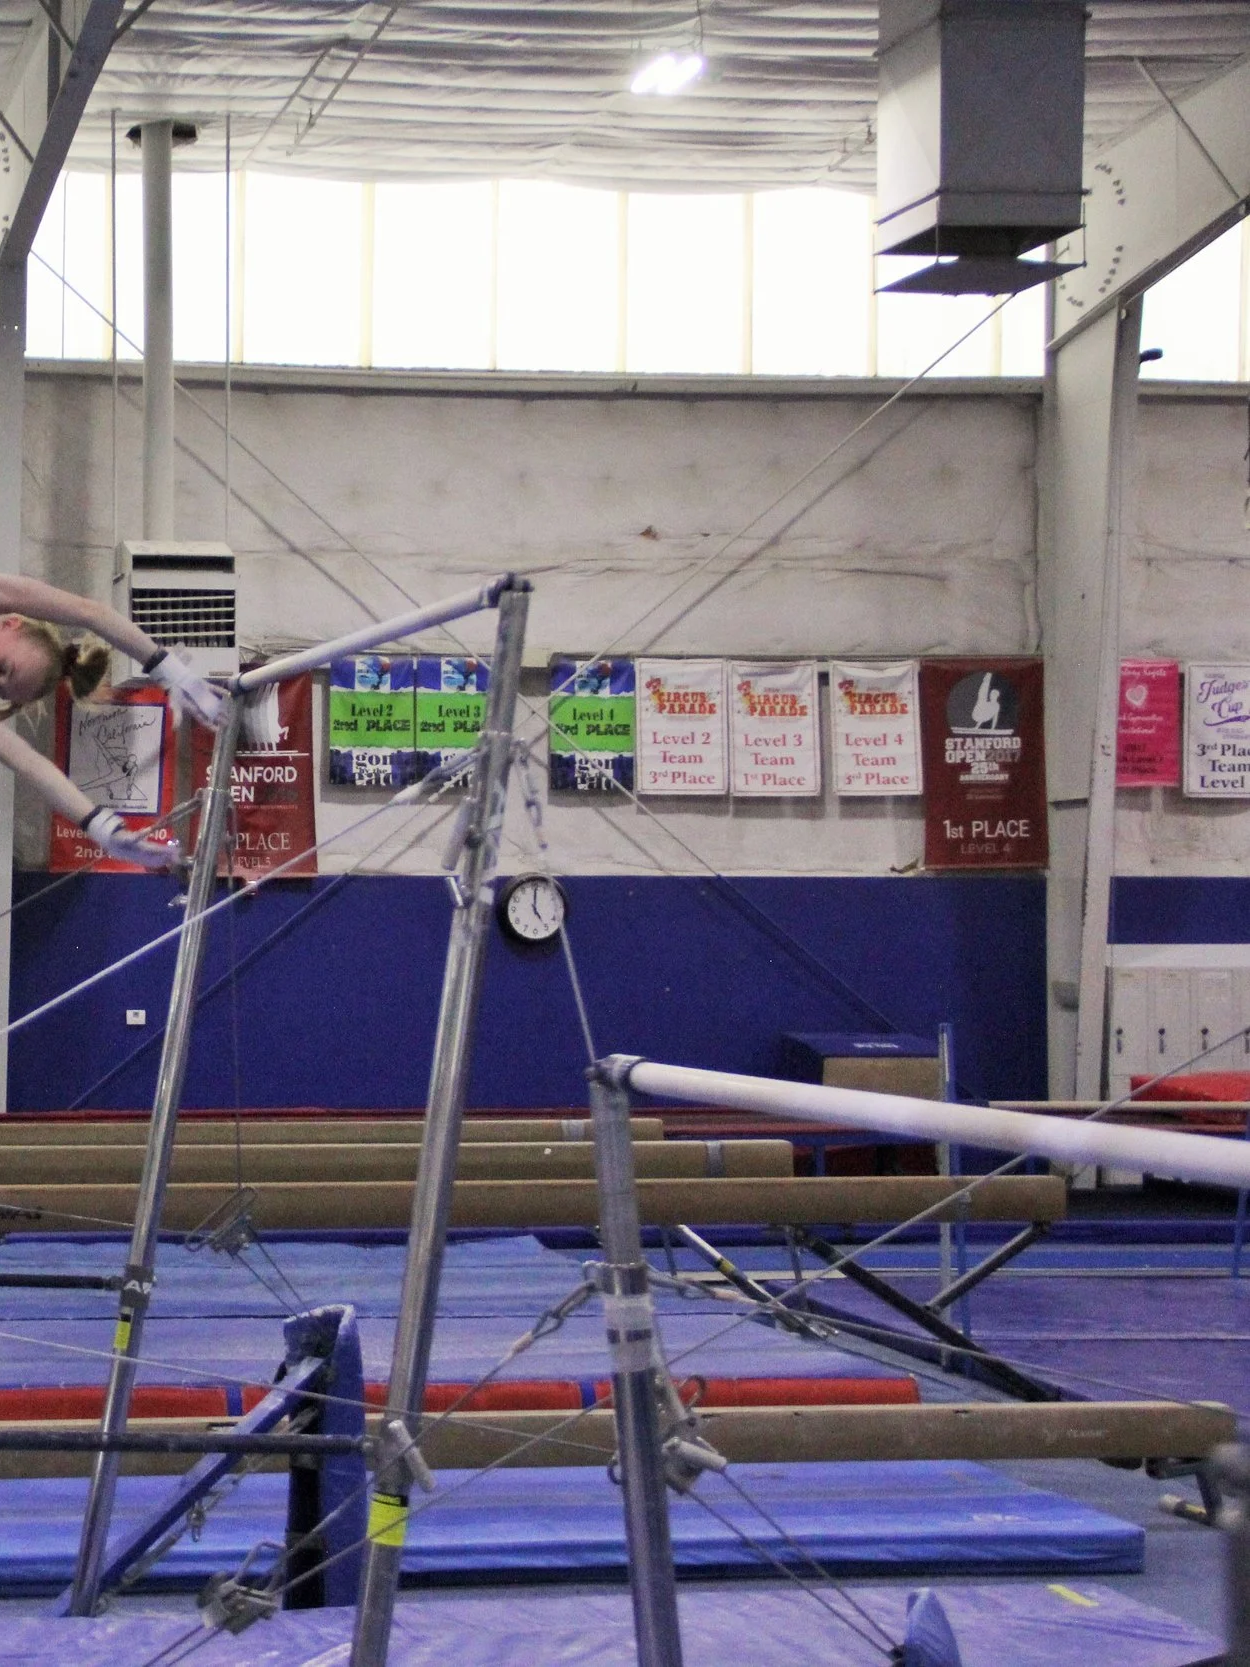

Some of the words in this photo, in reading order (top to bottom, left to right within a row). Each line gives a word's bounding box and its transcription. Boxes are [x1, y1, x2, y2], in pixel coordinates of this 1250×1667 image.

[659, 692, 708, 703] CIRCUS
[749, 694, 798, 706] CIRCUS
[849, 692, 898, 704] CIRCUS
[351, 704, 383, 717] Level
[386, 705, 393, 716] 2
[438, 705, 470, 718] Level
[474, 706, 481, 718] 3
[658, 703, 717, 714] PARADE
[749, 705, 808, 716] PARADE
[850, 704, 909, 715] PARADE
[1211, 697, 1243, 718] Cup
[572, 708, 603, 721] Level
[97, 716, 156, 745] California
[333, 720, 358, 732] 2nd
[366, 720, 411, 732] PLACE
[420, 720, 445, 733] 2nd
[453, 721, 481, 733] PLA
[586, 724, 631, 736] PLACE
[653, 732, 695, 744] Level
[702, 732, 711, 744] 2
[744, 734, 786, 747] Level
[793, 734, 802, 746] 3
[845, 733, 887, 746] Level
[894, 733, 904, 745] 4
[945, 737, 1021, 750] STANFORD
[945, 750, 986, 763] OPEN
[986, 750, 1021, 762] 2017
[1197, 743, 1217, 757] 3rd
[660, 751, 703, 764] Team
[752, 753, 795, 765] Team
[853, 753, 896, 766] Team
[206, 766, 297, 783] SANFORD
[649, 770, 668, 784] 3rd
[672, 771, 715, 784] Place
[744, 773, 759, 786] 1st
[762, 773, 806, 785] Place
[865, 772, 909, 785] Place
[1200, 775, 1245, 789] Level
[230, 786, 254, 802] EN
[56, 826, 87, 839] Leve
[943, 820, 964, 839] 1st
[972, 820, 1030, 838] PLACE
[236, 832, 291, 850] PLACE
[74, 847, 103, 859] 2nd
[961, 843, 999, 854] LEVEL
[263, 856, 271, 868] 5
